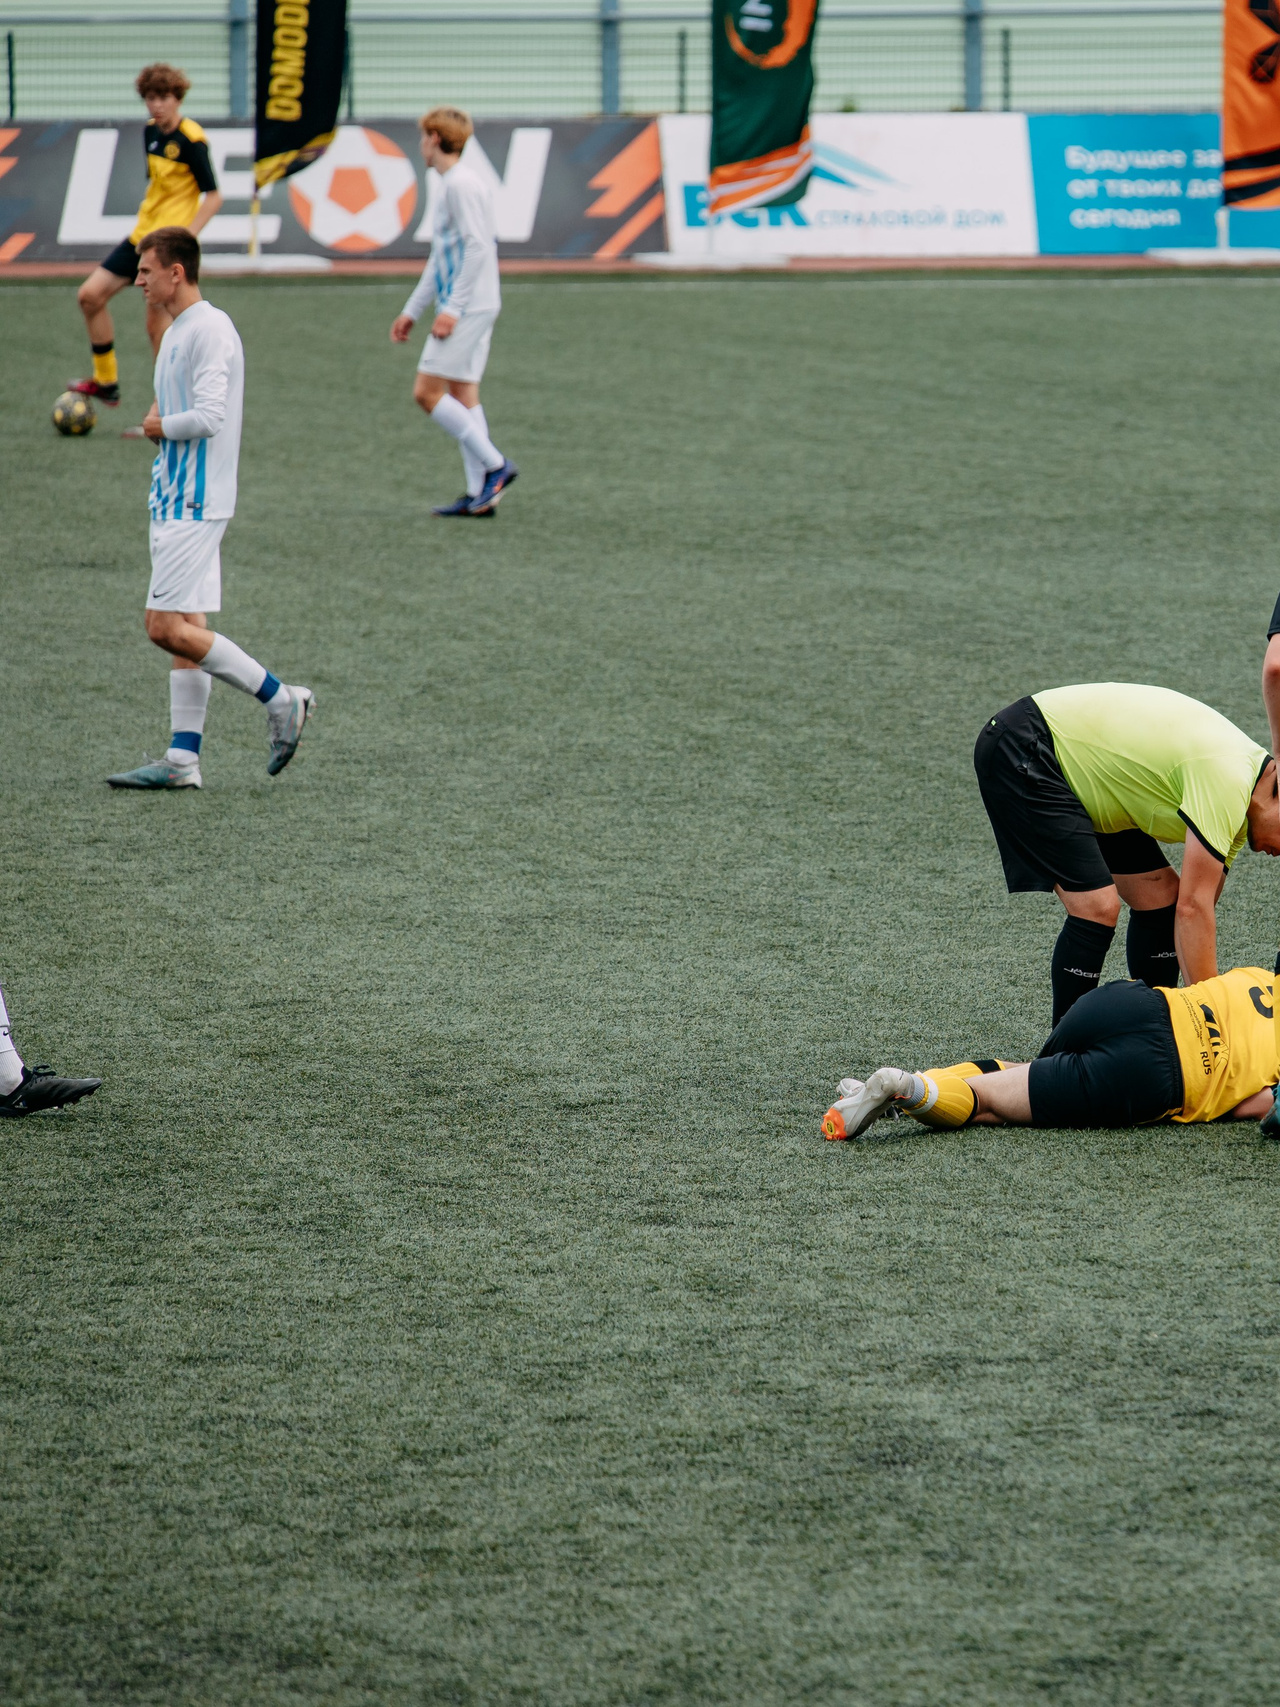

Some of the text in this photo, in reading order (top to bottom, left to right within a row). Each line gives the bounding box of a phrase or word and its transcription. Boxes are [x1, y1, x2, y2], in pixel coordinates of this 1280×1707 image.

[265, 0, 310, 121] DOMOD
[1064, 145, 1187, 174] Будущее
[1069, 208, 1182, 230] сегодня
[1200, 1051, 1212, 1075] RUS
